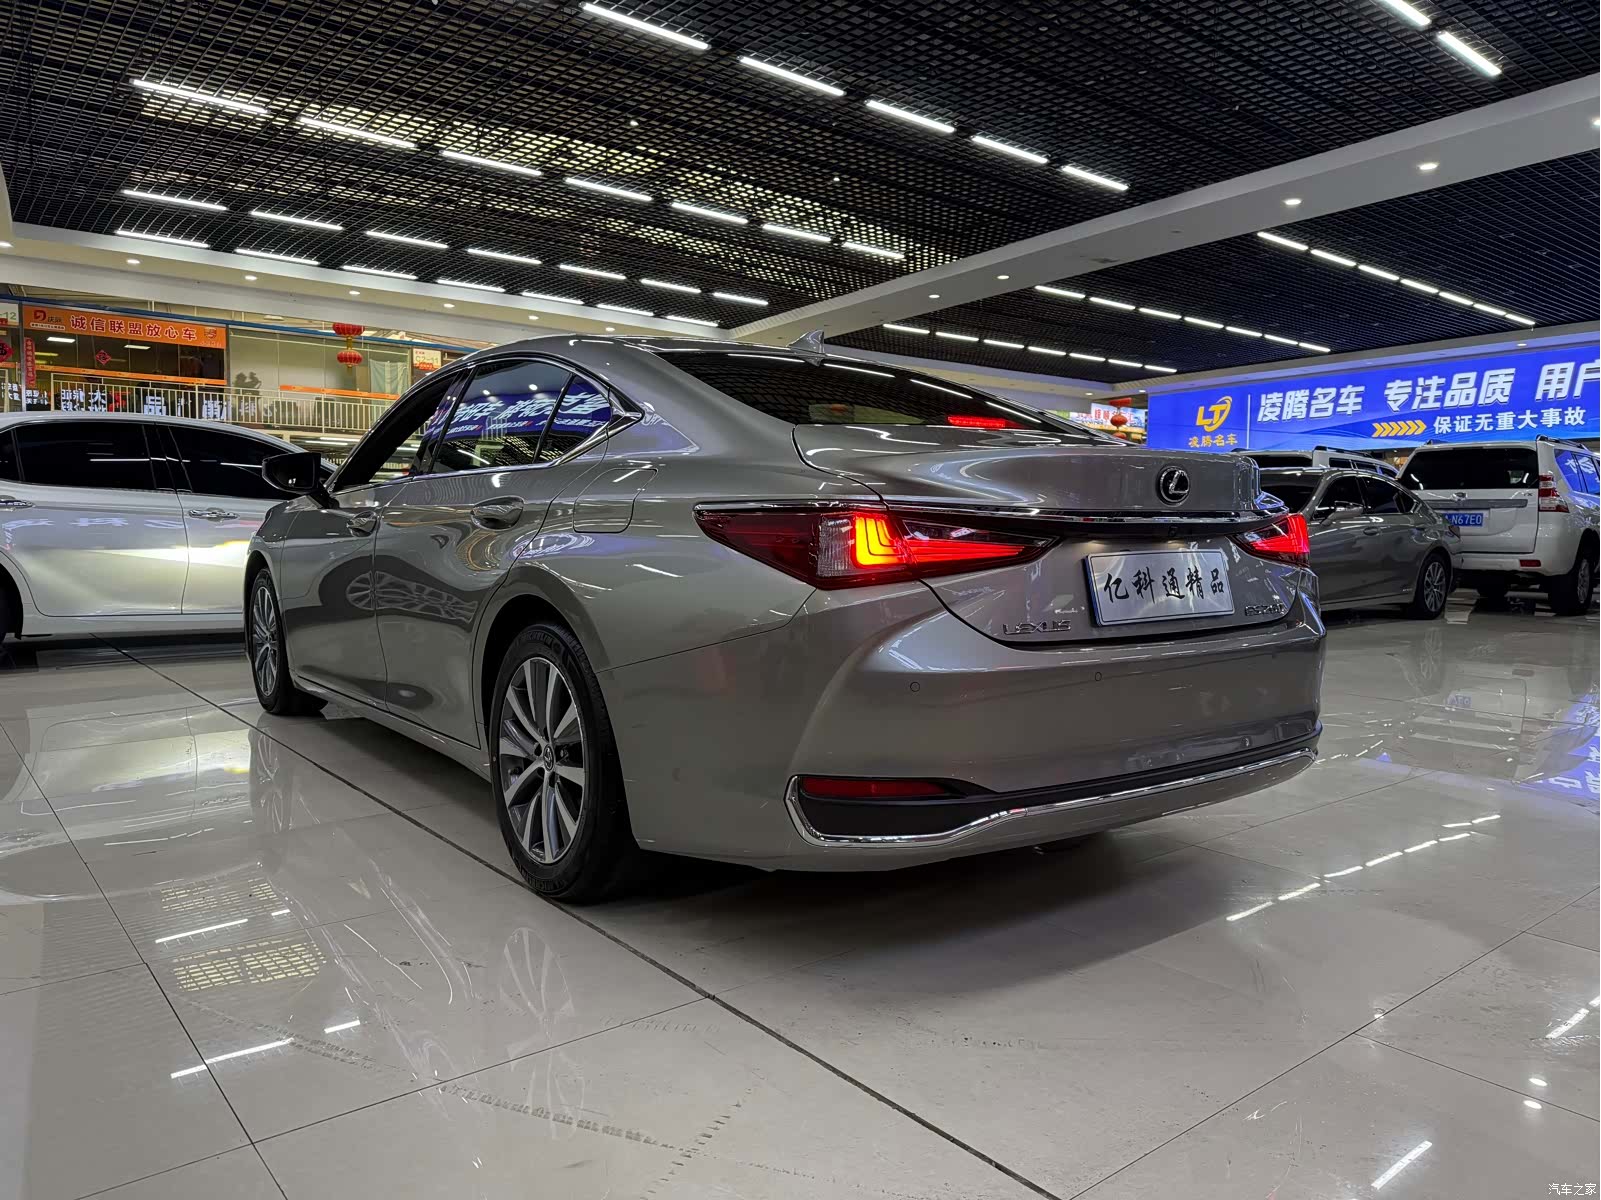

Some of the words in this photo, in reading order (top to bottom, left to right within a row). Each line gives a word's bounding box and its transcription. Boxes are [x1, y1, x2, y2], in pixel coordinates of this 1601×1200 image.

[70, 314, 197, 341] 诚信联盟放心车
[1257, 383, 1365, 424] 凌腾名车
[1383, 367, 1517, 414] 专注品质
[1432, 405, 1587, 435] 保证无重大事故
[1188, 433, 1239, 449] 凌腾名车
[1103, 565, 1226, 604] 亿科通精品
[1002, 618, 1073, 636] LEXUS
